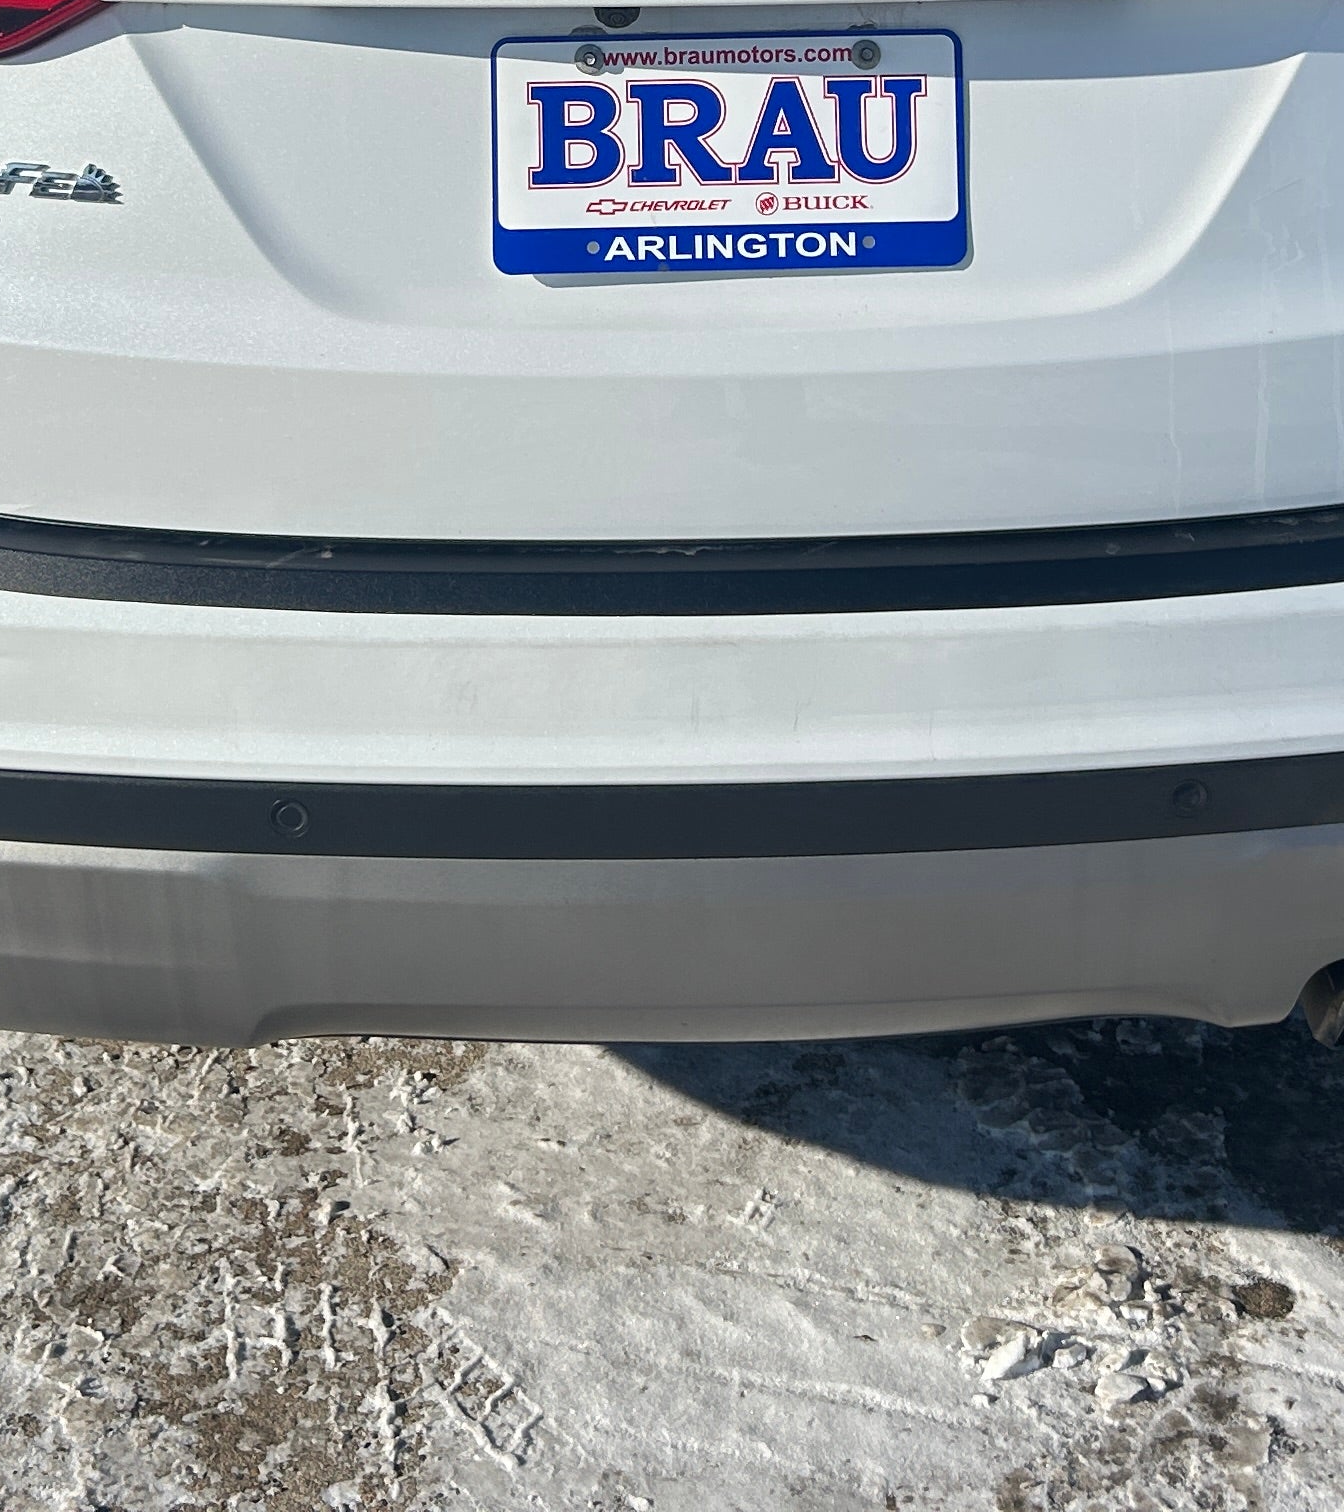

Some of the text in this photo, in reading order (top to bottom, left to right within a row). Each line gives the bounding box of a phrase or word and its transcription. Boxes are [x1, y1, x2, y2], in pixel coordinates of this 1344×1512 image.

[601, 45, 853, 68] www.braumotors.com
[527, 74, 928, 190] BRAU
[629, 198, 732, 213] CHEVROLET
[782, 195, 870, 211] BUICK
[604, 231, 856, 262] ARLINGTON
